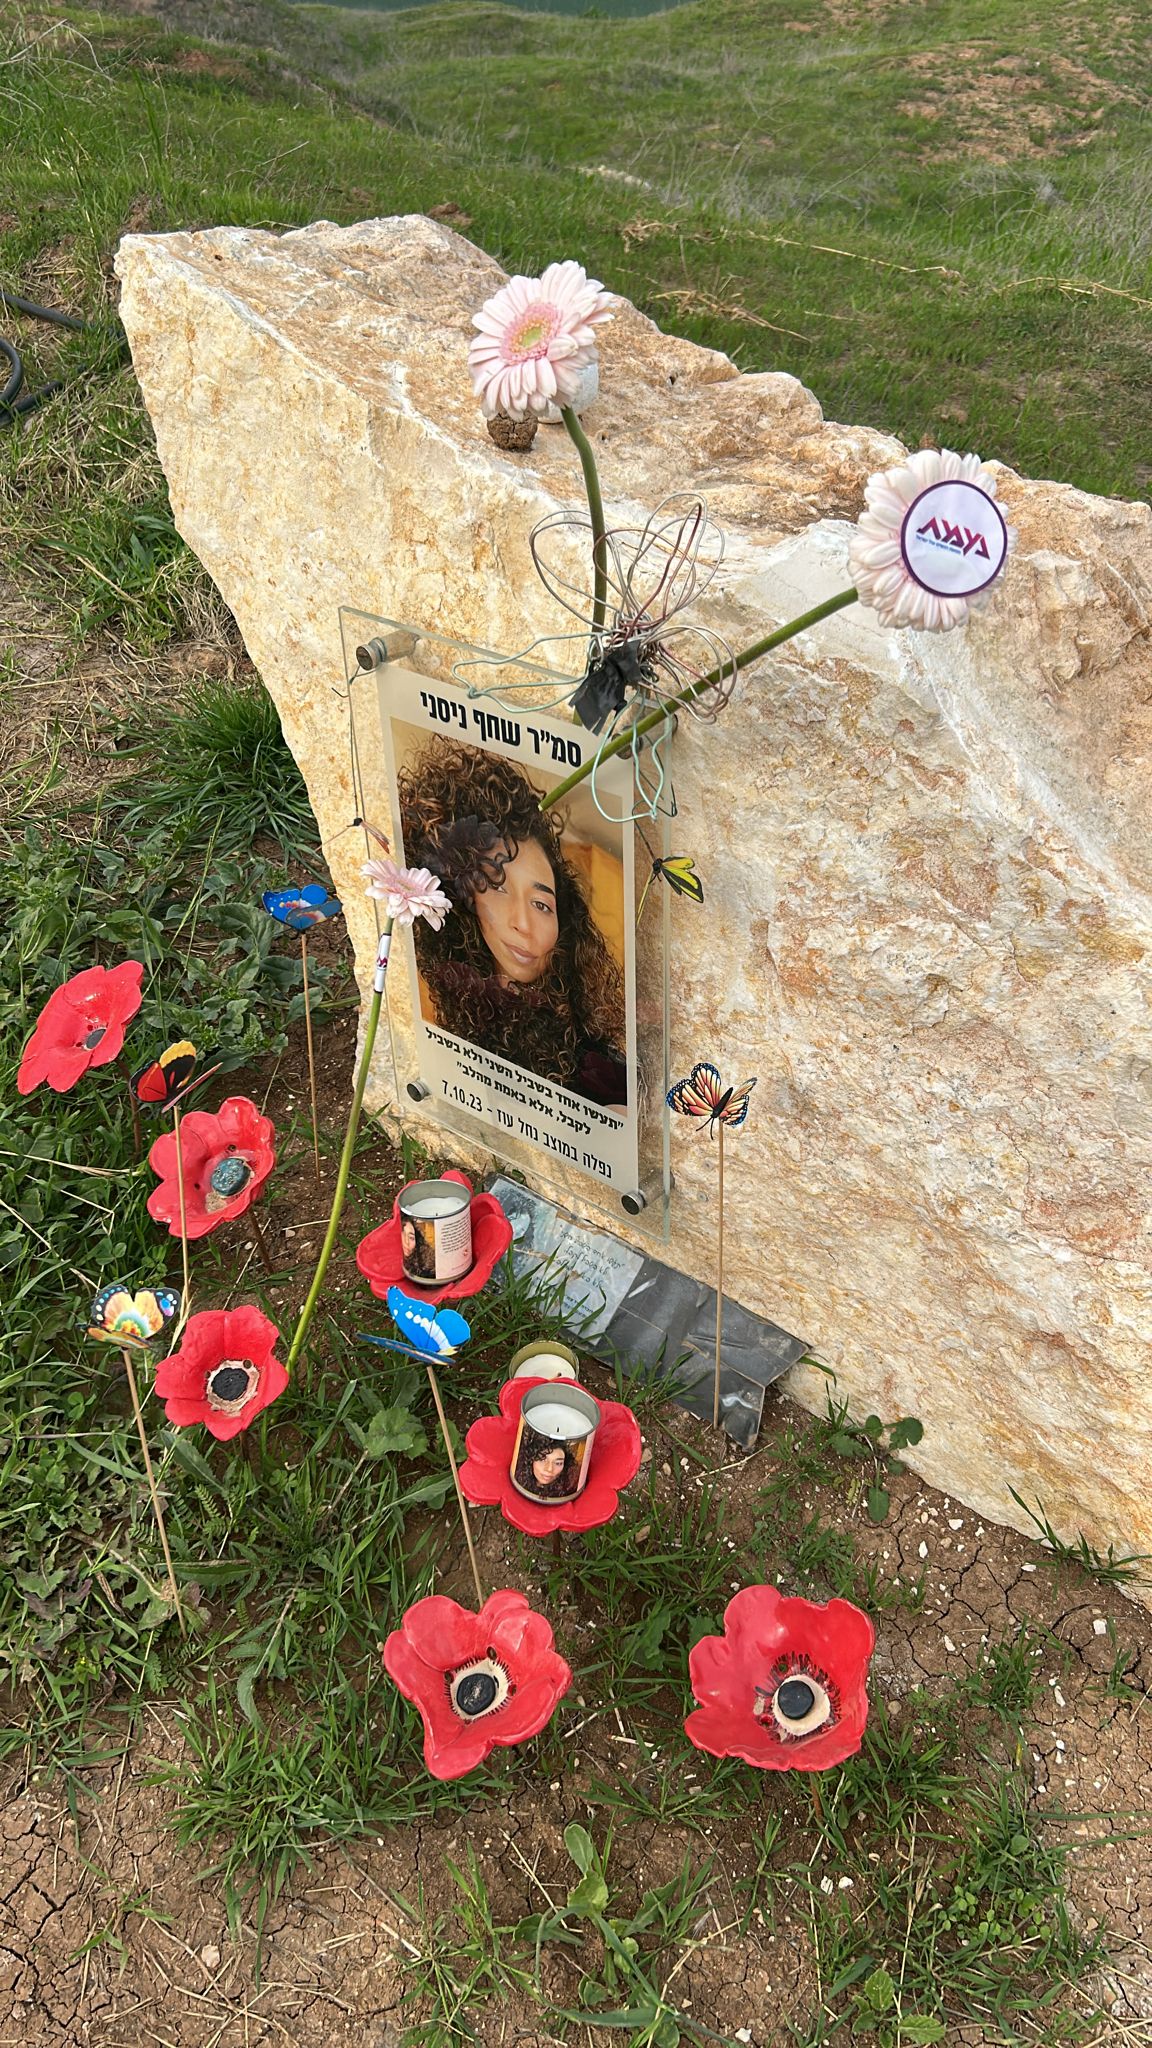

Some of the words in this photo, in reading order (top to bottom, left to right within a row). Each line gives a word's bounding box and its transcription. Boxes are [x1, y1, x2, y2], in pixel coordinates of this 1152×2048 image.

[419, 690, 468, 730] ניסני
[472, 708, 521, 747] שחף
[526, 726, 582, 768] סמ"ר
[424, 1026, 461, 1054] בשביל
[462, 1046, 483, 1065] ולא
[484, 1057, 513, 1079] השני
[441, 1079, 483, 1113] 7.10.23
[494, 1080, 527, 1105] באמת
[514, 1069, 553, 1099] בשביל
[528, 1097, 554, 1118] אלא
[555, 1091, 581, 1112] אחד
[496, 1108, 514, 1128] עוז
[517, 1117, 539, 1142] נחל
[556, 1110, 591, 1135] לקבל,
[542, 1131, 579, 1162] במוצב
[582, 1152, 612, 1179] נפלה
